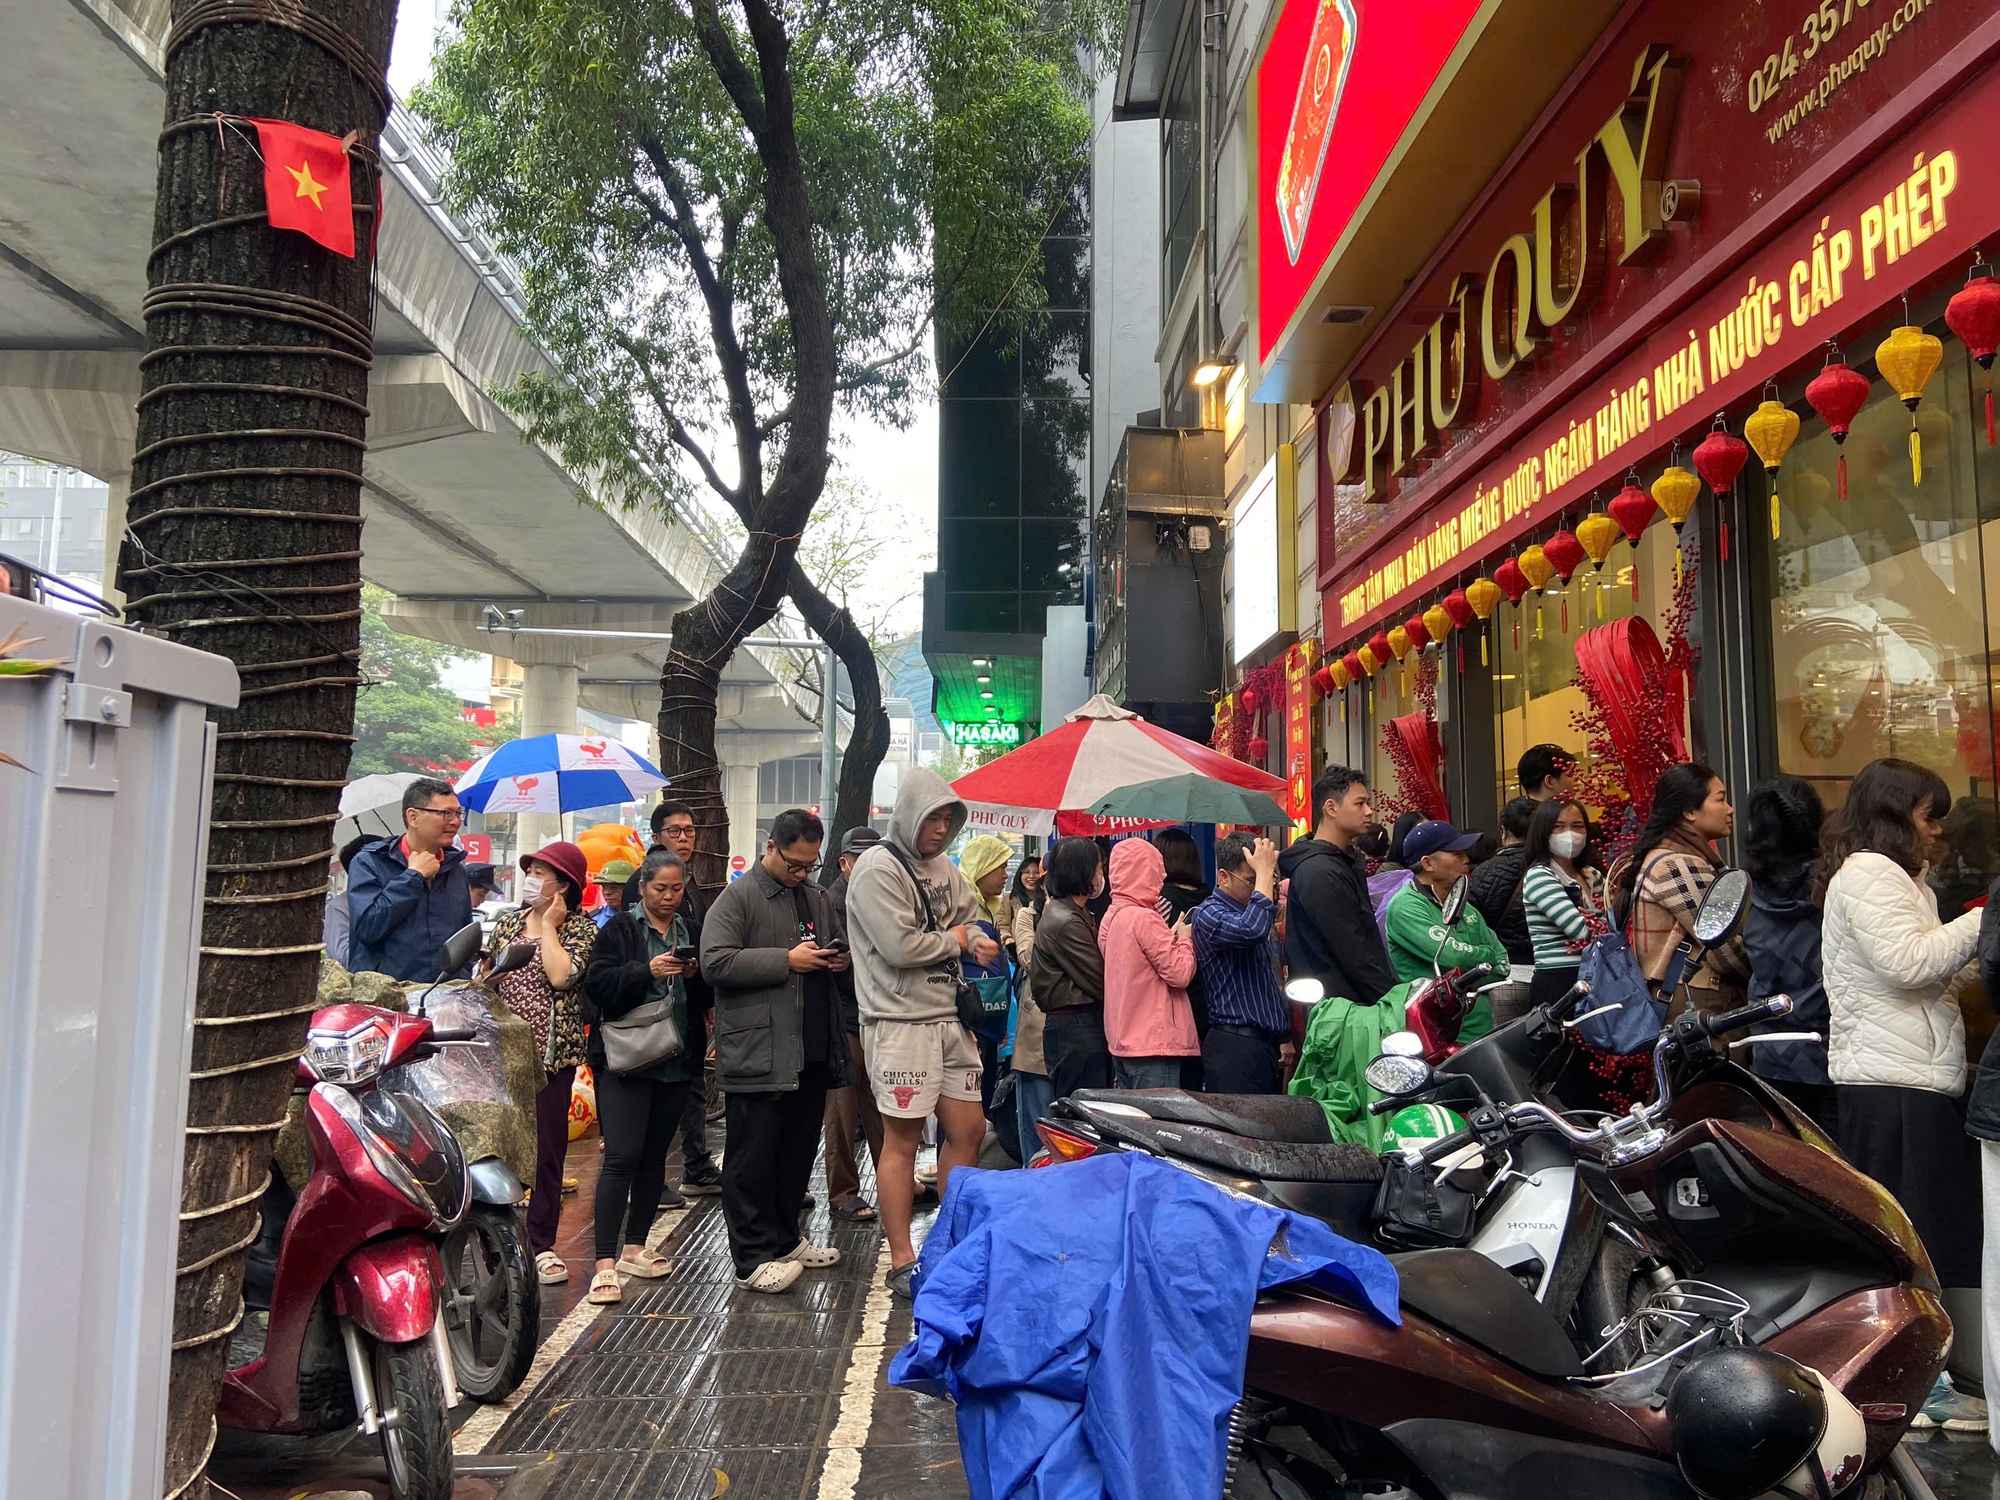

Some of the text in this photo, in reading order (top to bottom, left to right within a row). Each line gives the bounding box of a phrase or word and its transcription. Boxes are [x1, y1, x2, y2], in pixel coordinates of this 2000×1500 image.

[1748, 35, 1799, 113] 024
[1363, 272, 1472, 504] PHÚ
[1481, 46, 1670, 381] QUÝ
[1340, 583, 1367, 628] TRUNG
[1383, 554, 1406, 601] MUA
[1406, 537, 1428, 586] BÁN
[1427, 521, 1460, 572] VÀNG
[1460, 482, 1501, 551] MIẾNG
[1503, 456, 1542, 522] ĐƯỢC
[1544, 418, 1594, 495] NGÂN
[1596, 376, 1650, 461] HÀNG
[1654, 329, 1705, 422] NHÀ
[1708, 276, 1782, 385] NƯỚC
[1788, 215, 1853, 327] CẤP
[1860, 150, 1958, 281] PHÉP
[957, 725, 1018, 742] HASAKI
[970, 810, 1029, 830] PHÚ QUÝ
[883, 1070, 928, 1079] CHICAGO
[888, 1078, 921, 1086] BULLS
[1507, 1222, 1558, 1230] HONDA
